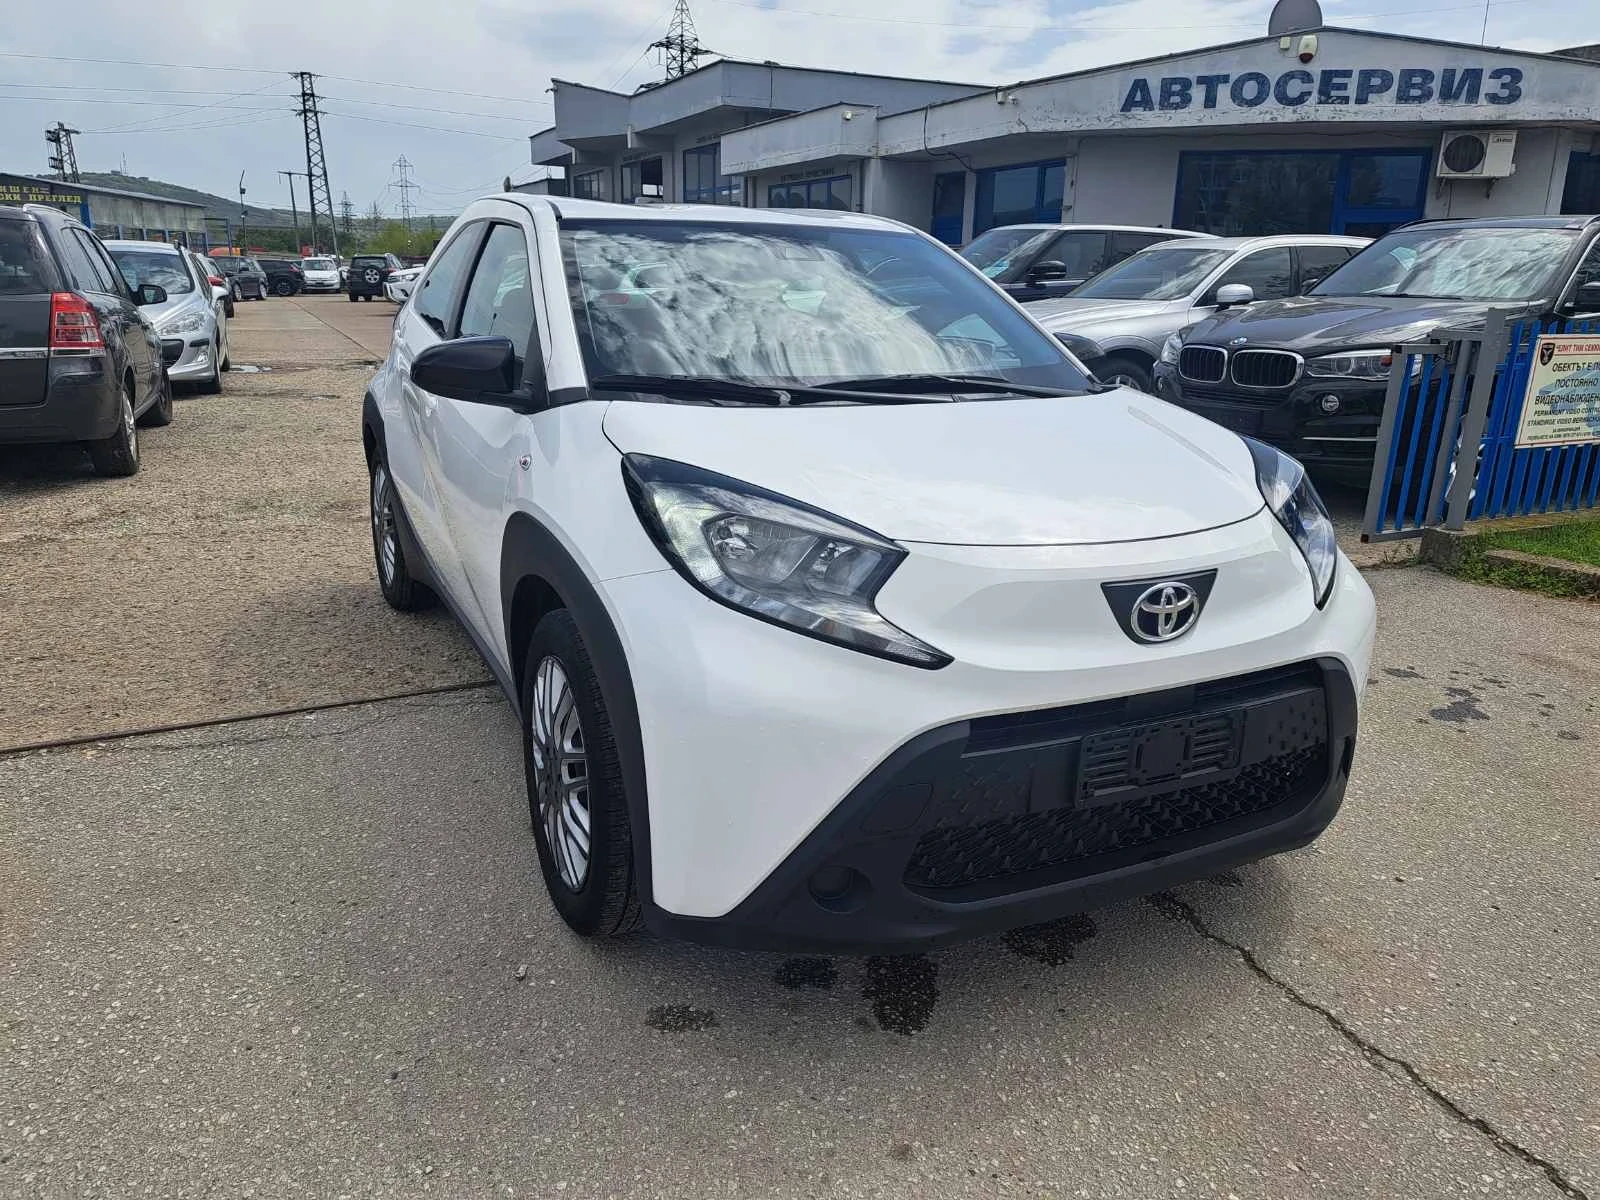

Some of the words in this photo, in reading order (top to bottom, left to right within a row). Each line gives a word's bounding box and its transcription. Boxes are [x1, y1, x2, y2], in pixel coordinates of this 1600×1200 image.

[1120, 68, 1523, 113] АВТОСЕРВИЗ
[29, 194, 81, 204] ПРЕГЛЕД
[1552, 362, 1586, 372] ОБЕКТЪТ
[1555, 378, 1598, 388] ПОСТОЯННО
